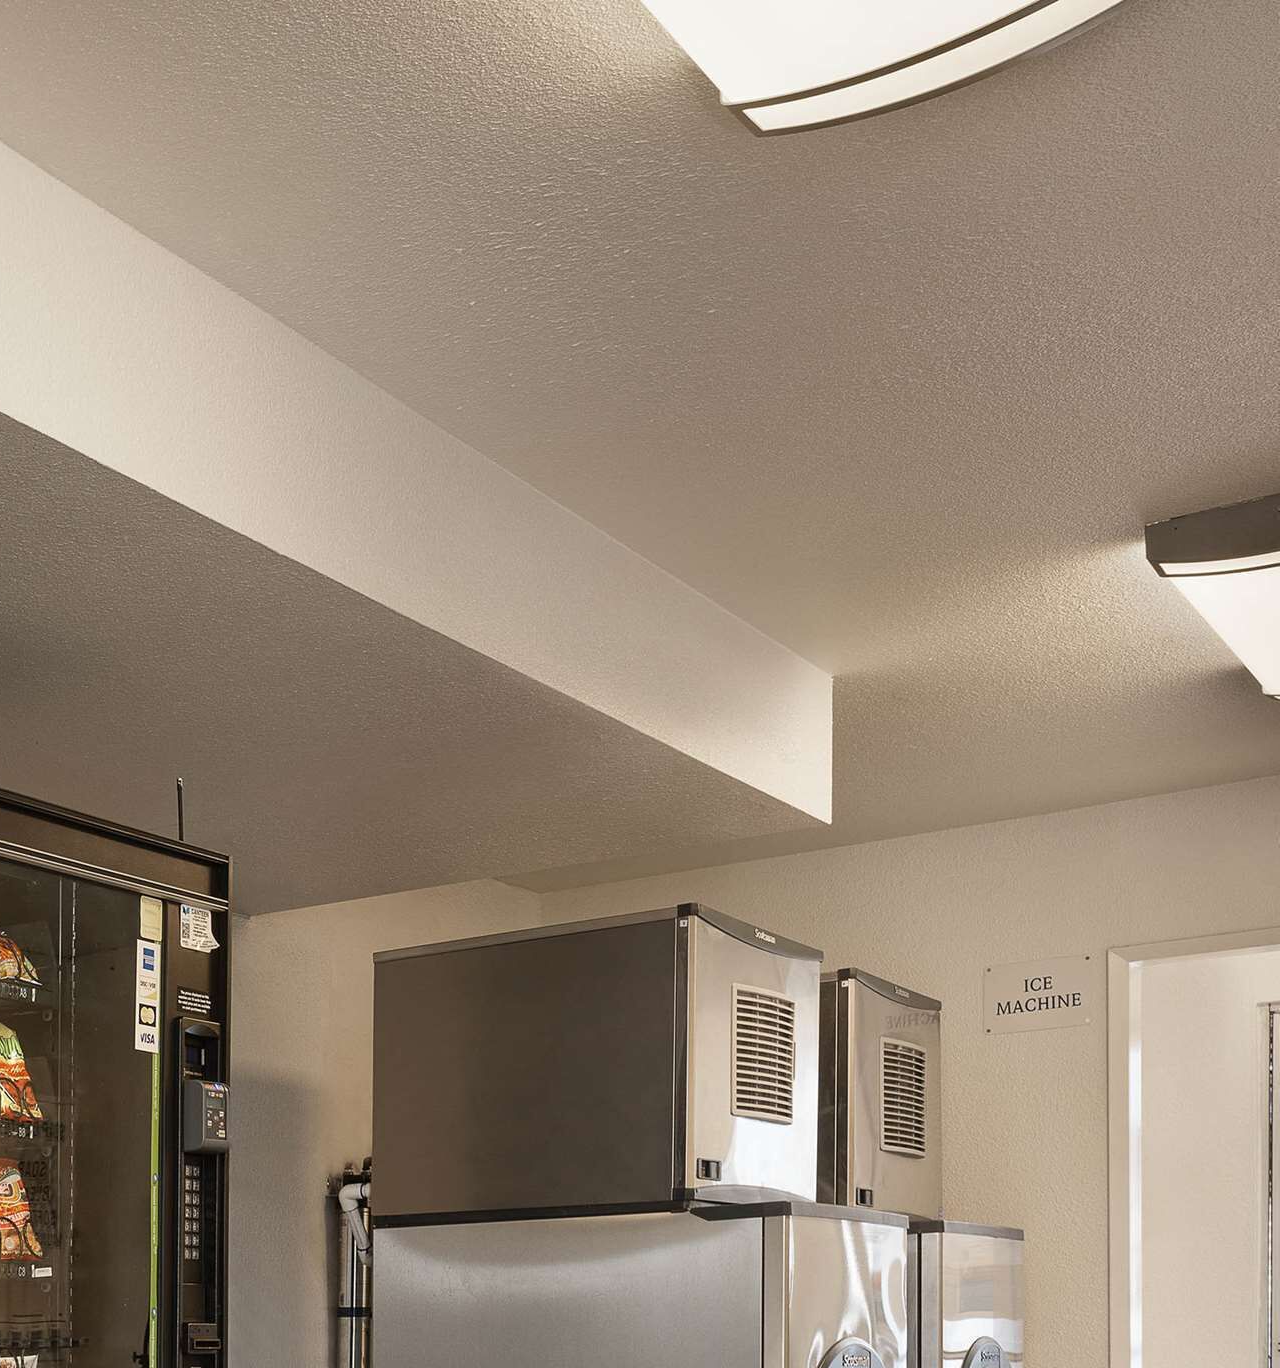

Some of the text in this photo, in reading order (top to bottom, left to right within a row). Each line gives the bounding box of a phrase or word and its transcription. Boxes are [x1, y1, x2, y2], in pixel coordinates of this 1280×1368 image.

[1024, 976, 1053, 993] ICE
[996, 993, 1082, 1016] MACHINE
[140, 1033, 155, 1045] VISA
